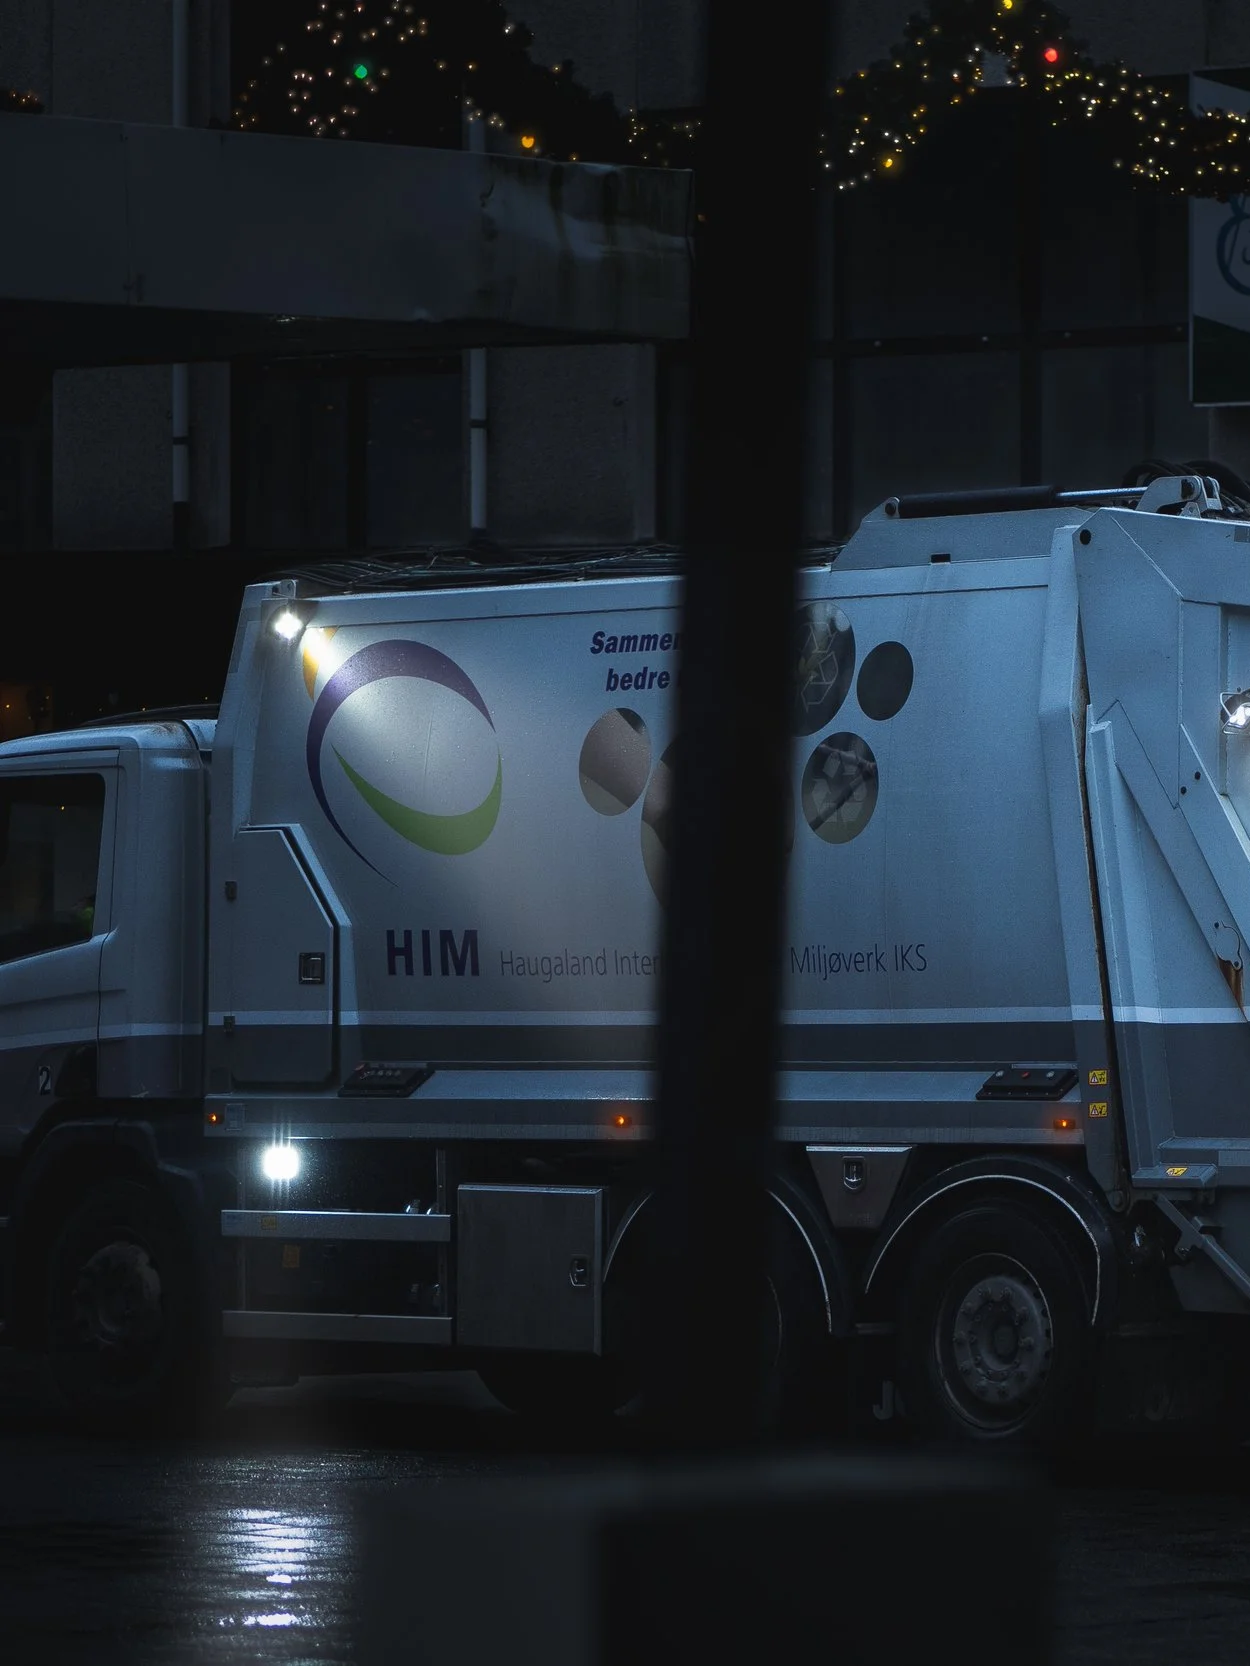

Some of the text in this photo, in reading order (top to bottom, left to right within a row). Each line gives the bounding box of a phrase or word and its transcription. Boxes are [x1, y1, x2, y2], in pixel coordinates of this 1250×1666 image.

[605, 667, 670, 692] bedre
[386, 929, 479, 976] HIM
[500, 948, 607, 983] Haugaland
[789, 943, 887, 981] Miljøverk
[894, 943, 927, 972] IKS
[39, 1066, 51, 1096] 2
